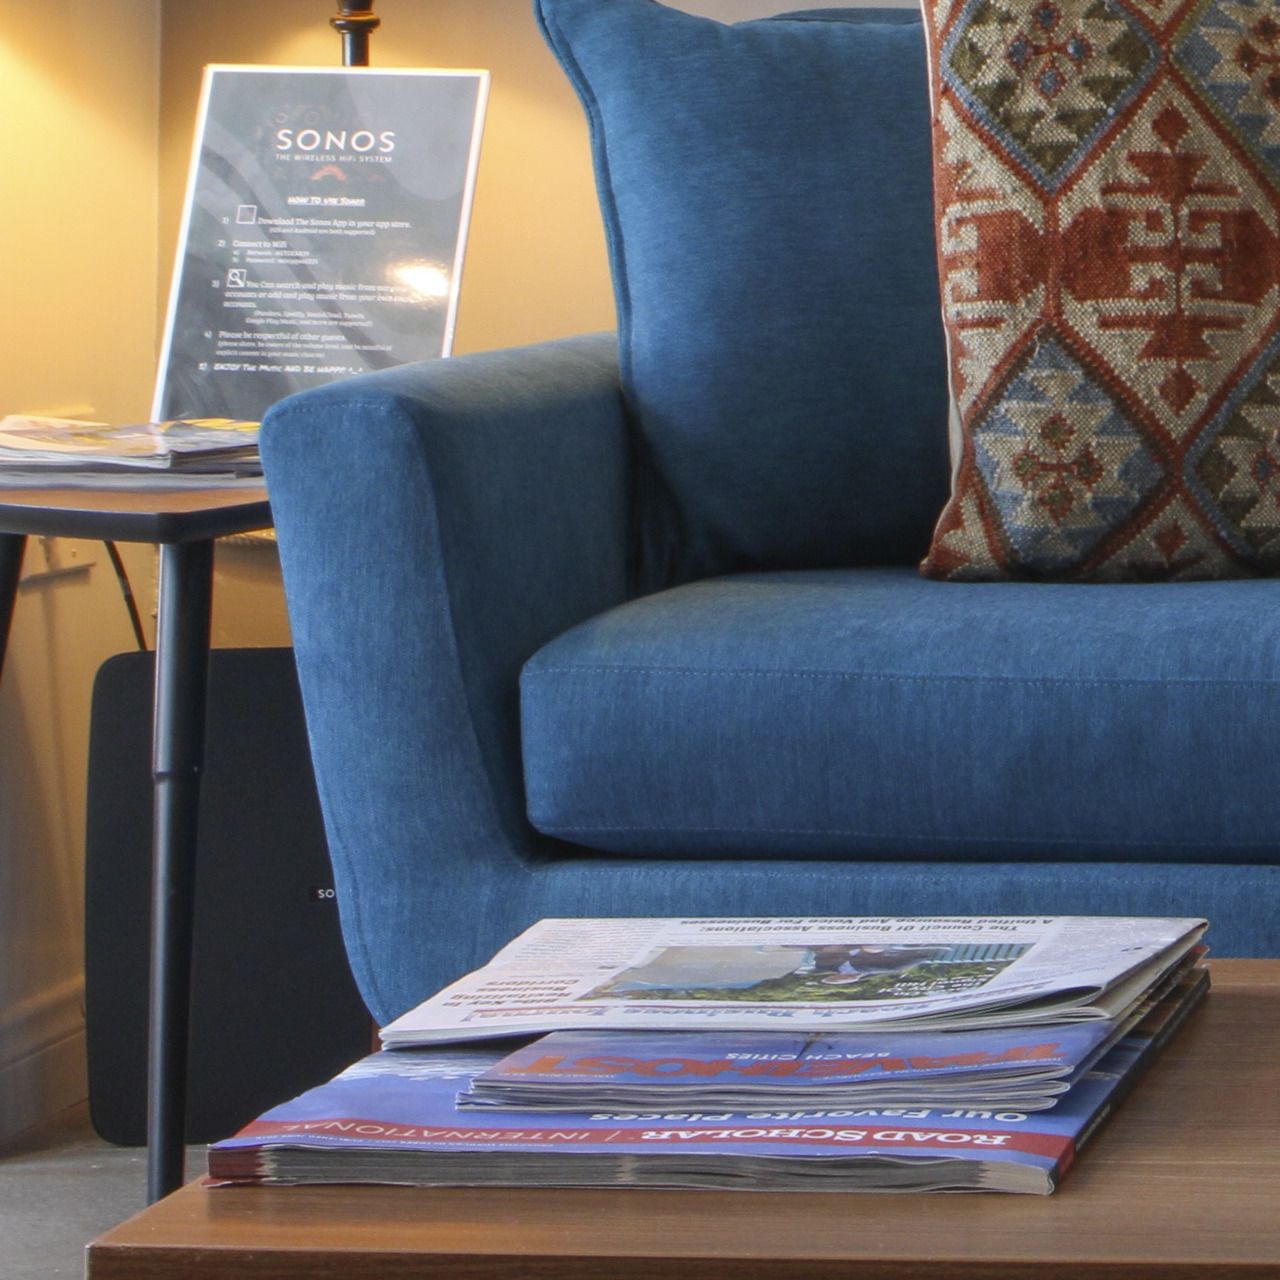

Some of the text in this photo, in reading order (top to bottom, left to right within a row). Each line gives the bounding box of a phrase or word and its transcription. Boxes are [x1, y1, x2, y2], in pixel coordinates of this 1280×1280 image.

[275, 129, 396, 152] SONOS
[724, 1052, 890, 1060] BEACH CITIES
[586, 1113, 734, 1122] Places
[942, 1110, 1030, 1122] Our
[872, 1131, 1012, 1145] ROAD
